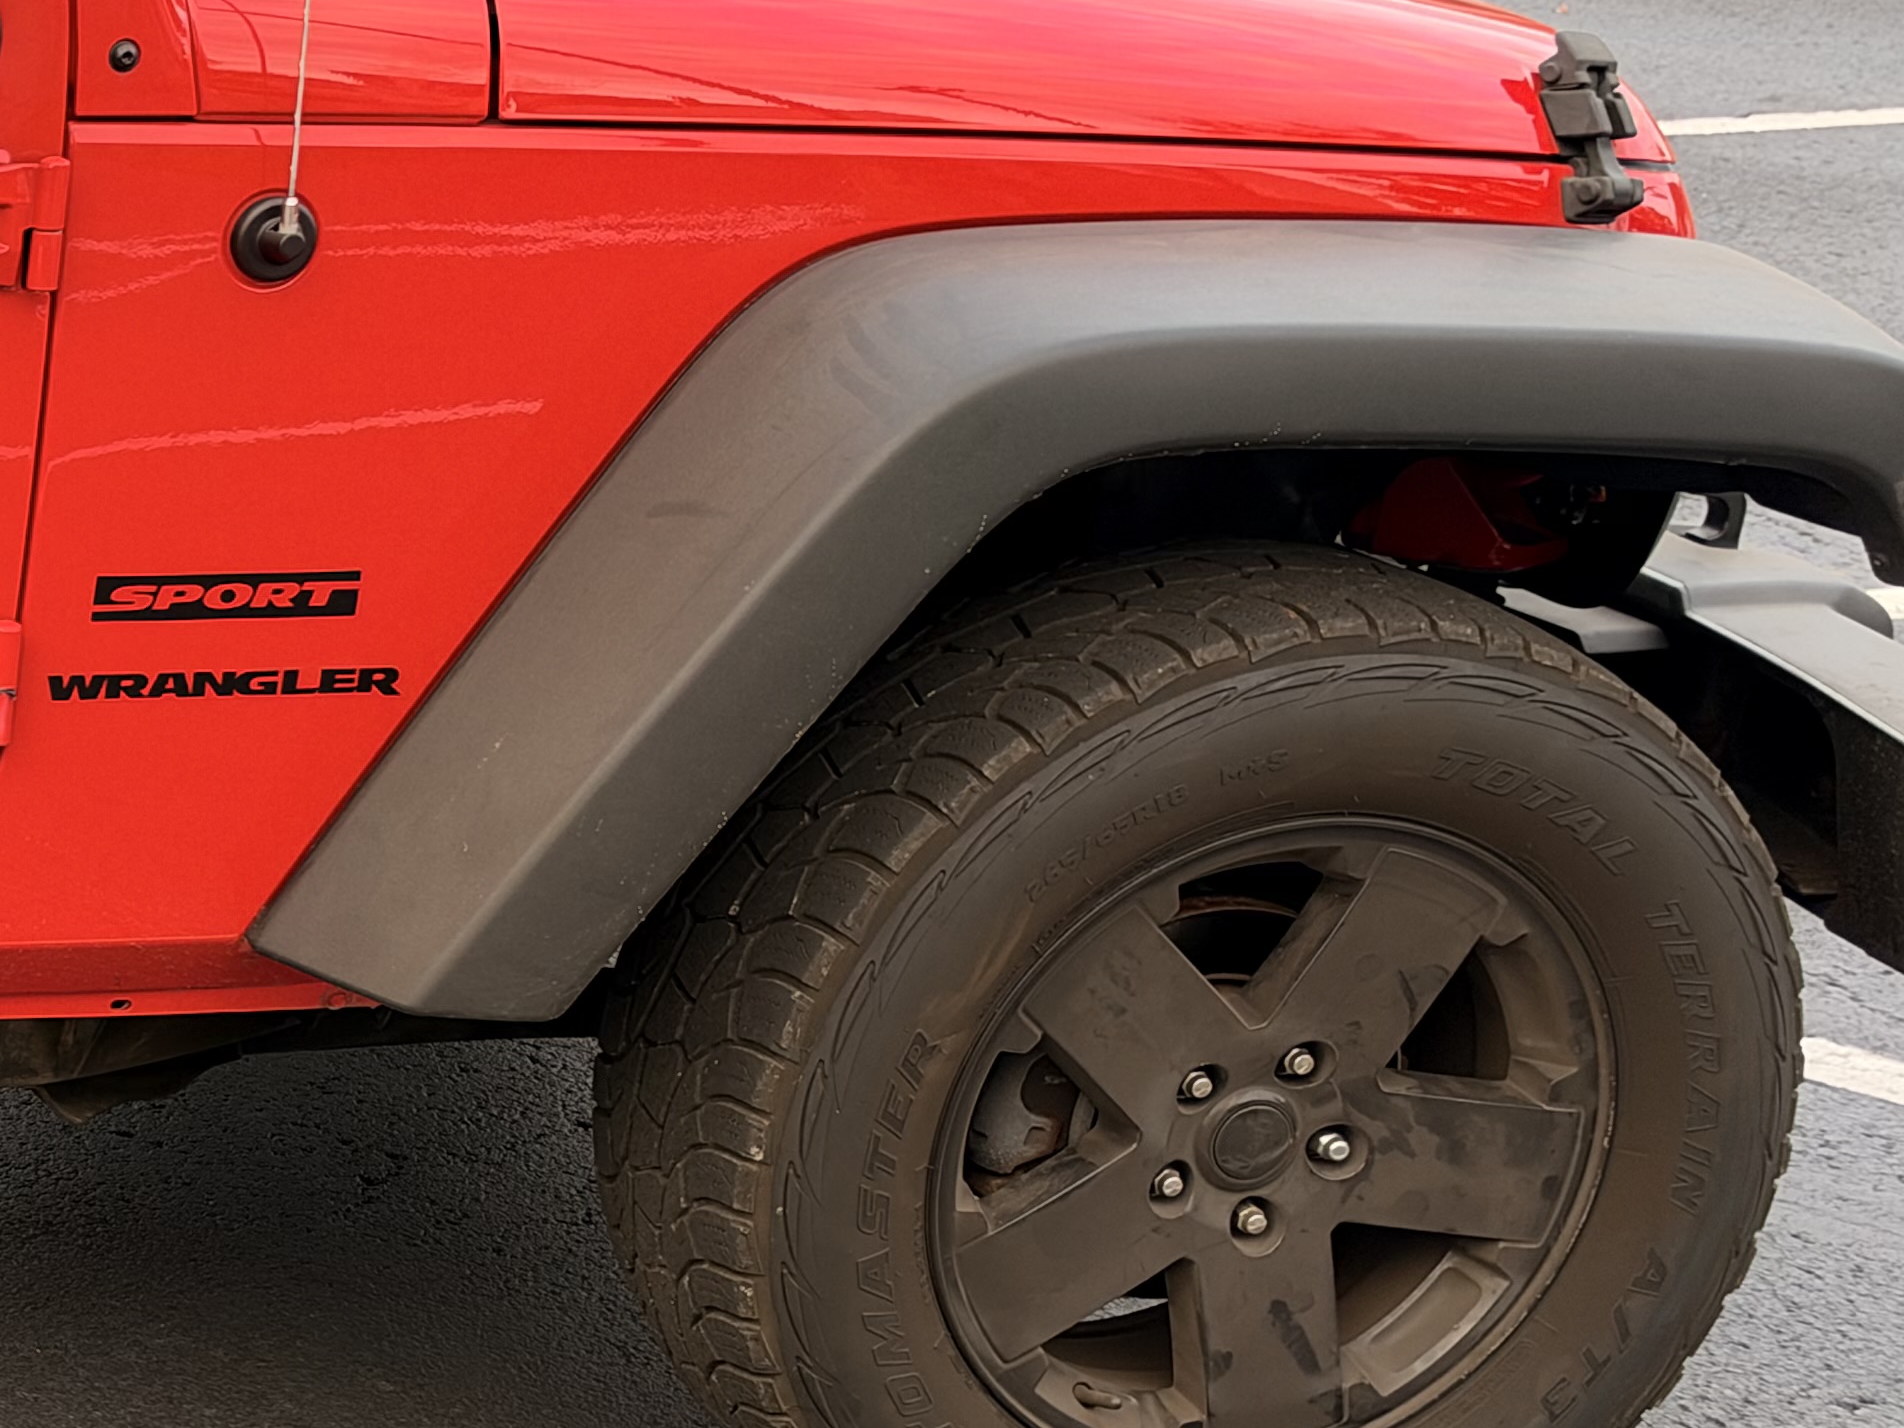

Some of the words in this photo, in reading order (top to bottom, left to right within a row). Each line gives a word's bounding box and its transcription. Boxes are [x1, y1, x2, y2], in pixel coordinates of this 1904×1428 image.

[93, 574, 361, 615] SPORT
[48, 667, 400, 702] WRANGLER
[1432, 747, 1639, 877] TOTAL
[1644, 899, 1722, 1215] TERRAIN
